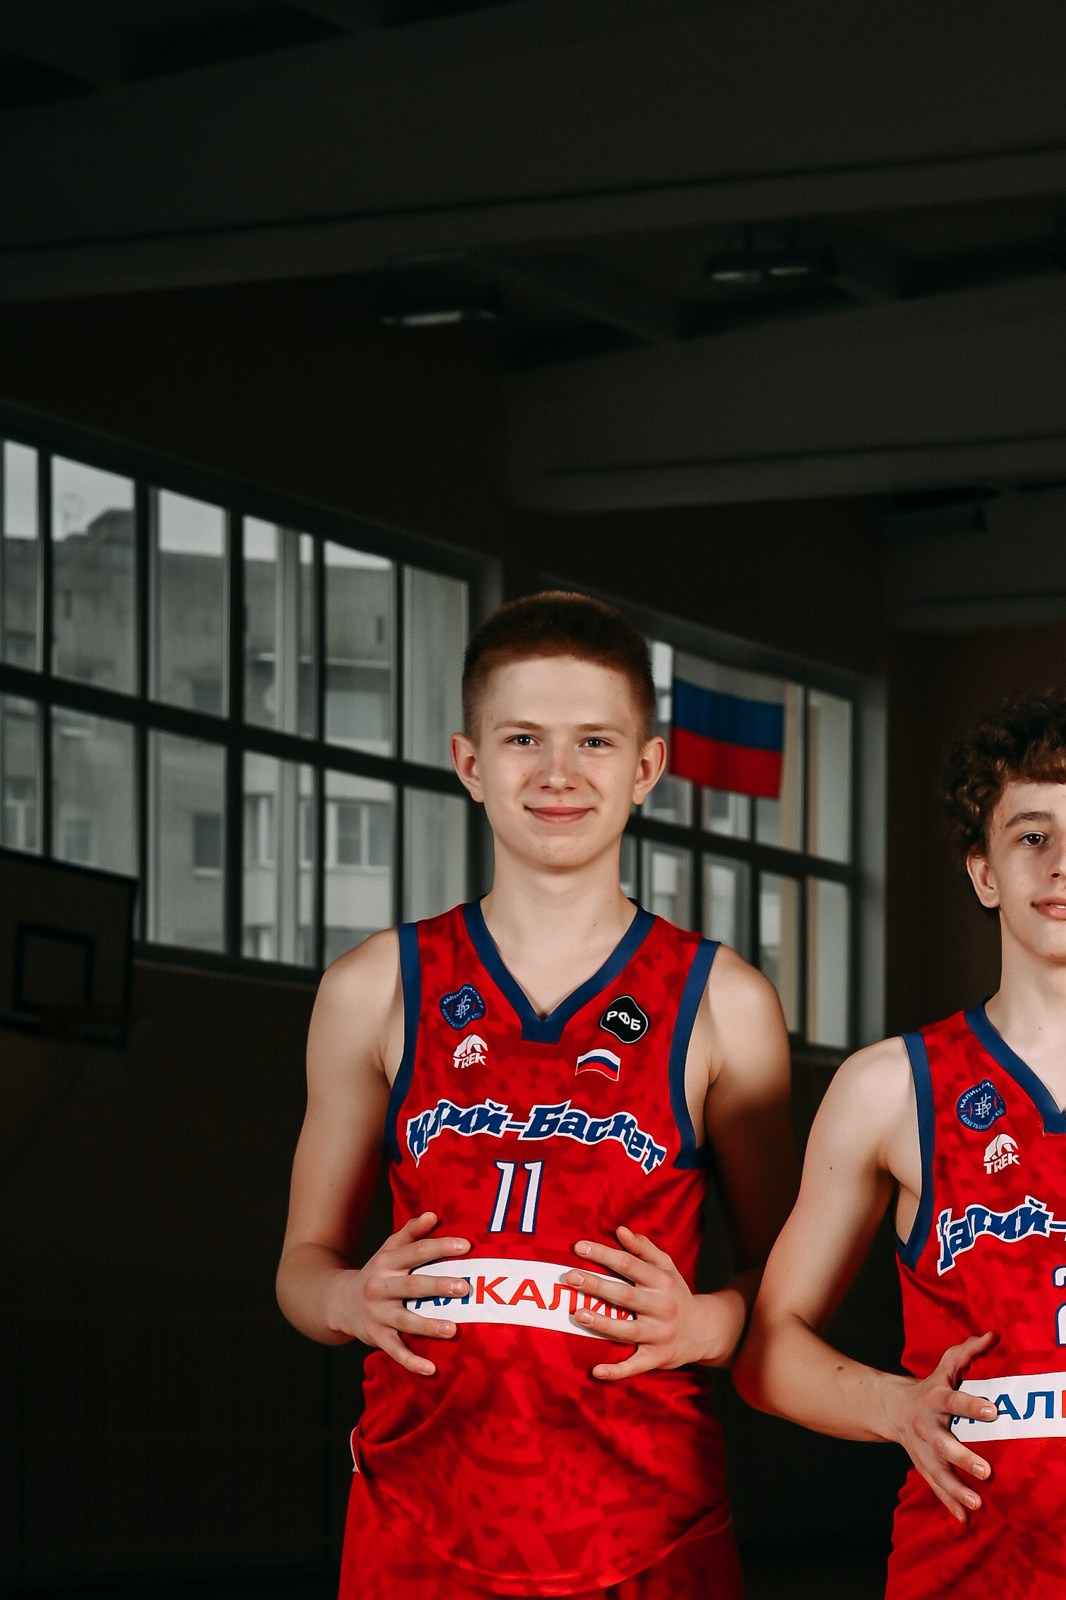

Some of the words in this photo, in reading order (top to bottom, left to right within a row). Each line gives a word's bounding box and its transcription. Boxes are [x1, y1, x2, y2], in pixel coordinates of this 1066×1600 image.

[606, 1010, 641, 1031] РФБ
[452, 1052, 487, 1069] TREK
[983, 1151, 1021, 1175] TREK
[487, 1158, 546, 1235] 11
